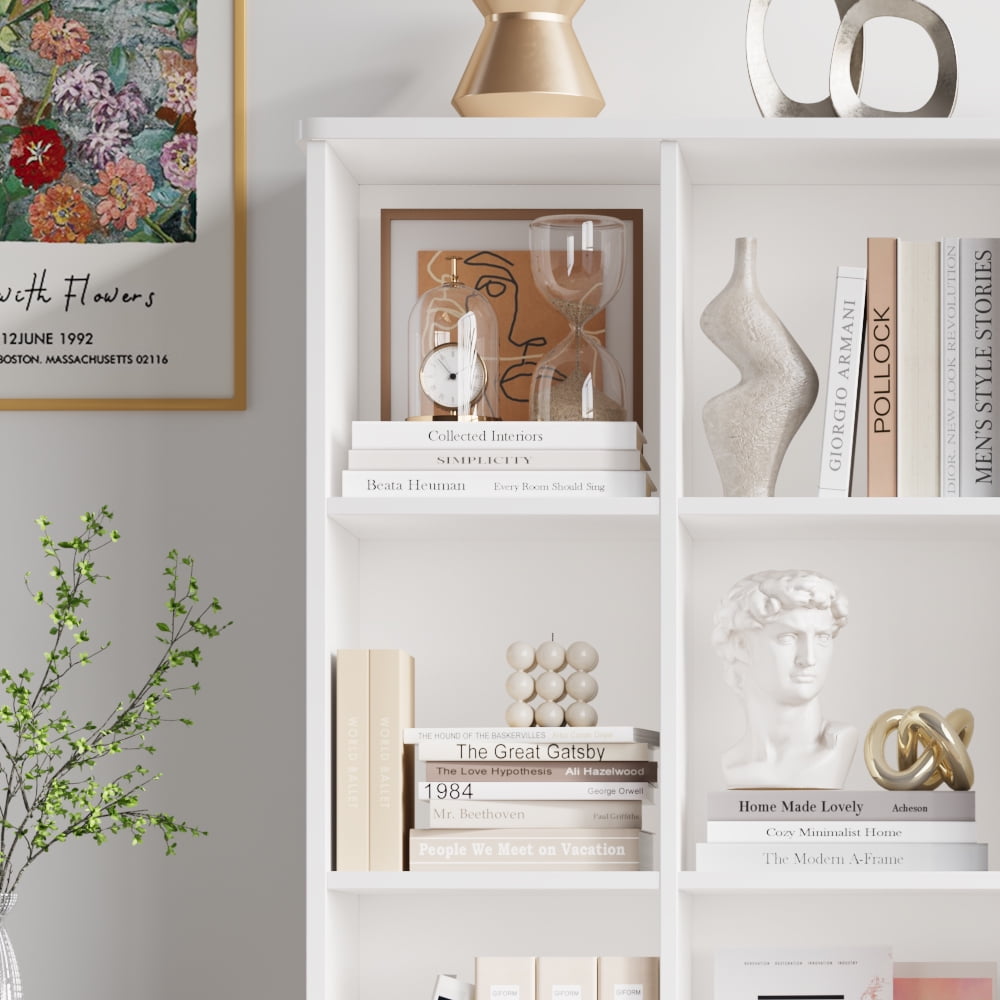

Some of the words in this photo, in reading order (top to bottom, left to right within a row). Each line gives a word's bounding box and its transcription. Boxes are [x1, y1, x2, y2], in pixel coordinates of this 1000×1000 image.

[64, 273, 155, 312] Flowers
[947, 245, 956, 351] REVOLUTION
[974, 249, 992, 341] STORIES
[2, 332, 53, 345] 12JUNE
[60, 332, 94, 345] 1992
[838, 299, 856, 379] ARMANI
[45, 354, 133, 364] MASSACHUSETTS
[136, 354, 169, 364] 02116
[873, 306, 891, 433] POLLOCK
[974, 345, 992, 413] STYLE
[829, 387, 848, 471] GIORGIO
[428, 430, 486, 442] Collected
[491, 430, 543, 442] Interiors
[974, 419, 992, 484] MEN'S
[437, 456, 531, 465] SIMPLICITY
[367, 479, 402, 491] Beata
[408, 479, 466, 491] Heuman
[494, 482, 519, 493] Every
[522, 482, 549, 493] Room
[551, 482, 583, 493] Should
[586, 482, 606, 493] Sing
[418, 732, 432, 740] THE
[434, 732, 461, 740] HOUND
[463, 732, 473, 740] OF
[475, 732, 489, 740] THE
[491, 732, 546, 740] BASKERVILLES
[457, 743, 488, 760] The
[494, 743, 540, 760] Great
[547, 743, 606, 761] Gatsby
[436, 767, 457, 777] The
[460, 767, 487, 777] Love
[491, 767, 552, 777] Hypothesis
[565, 767, 580, 777] Ali
[584, 767, 645, 777] Hazelwood
[424, 783, 473, 800] 1984
[588, 787, 616, 797] George
[619, 787, 644, 795] Orwell
[739, 801, 777, 812] Home
[781, 801, 817, 812] Made
[821, 801, 864, 816] Lovely
[892, 803, 928, 813] Acheson
[433, 809, 455, 820] Mr.
[460, 809, 525, 820] Beethoven
[766, 828, 796, 839] Cozy
[799, 828, 861, 838] Minimalist
[865, 828, 902, 838] Home
[419, 843, 467, 859] People
[472, 843, 493, 856] We
[498, 843, 534, 856] Meet
[538, 846, 557, 856] on
[562, 842, 625, 856] Vacation
[762, 853, 789, 865] The
[793, 853, 845, 865] Modern
[849, 853, 904, 865] A-Frame
